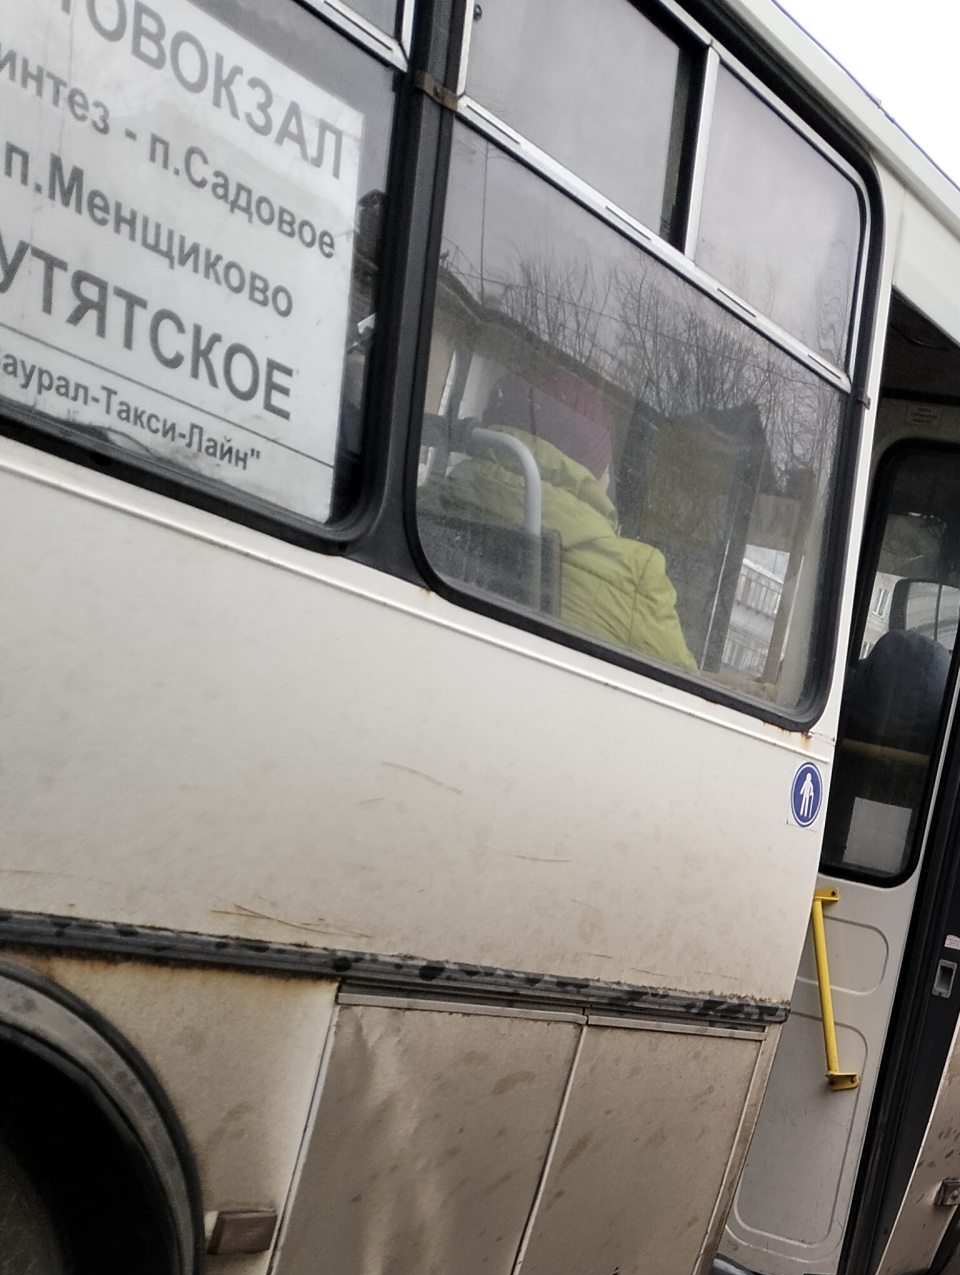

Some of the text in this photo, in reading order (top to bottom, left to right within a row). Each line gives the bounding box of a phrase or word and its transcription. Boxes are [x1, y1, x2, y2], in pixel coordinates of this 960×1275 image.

[61, 0, 344, 180] ОВОКЗАЛ
[4, 141, 294, 319] п.Менщиково
[149, 132, 336, 260] п.Садовое
[0, 228, 294, 421] УТЯТСКОЕ
